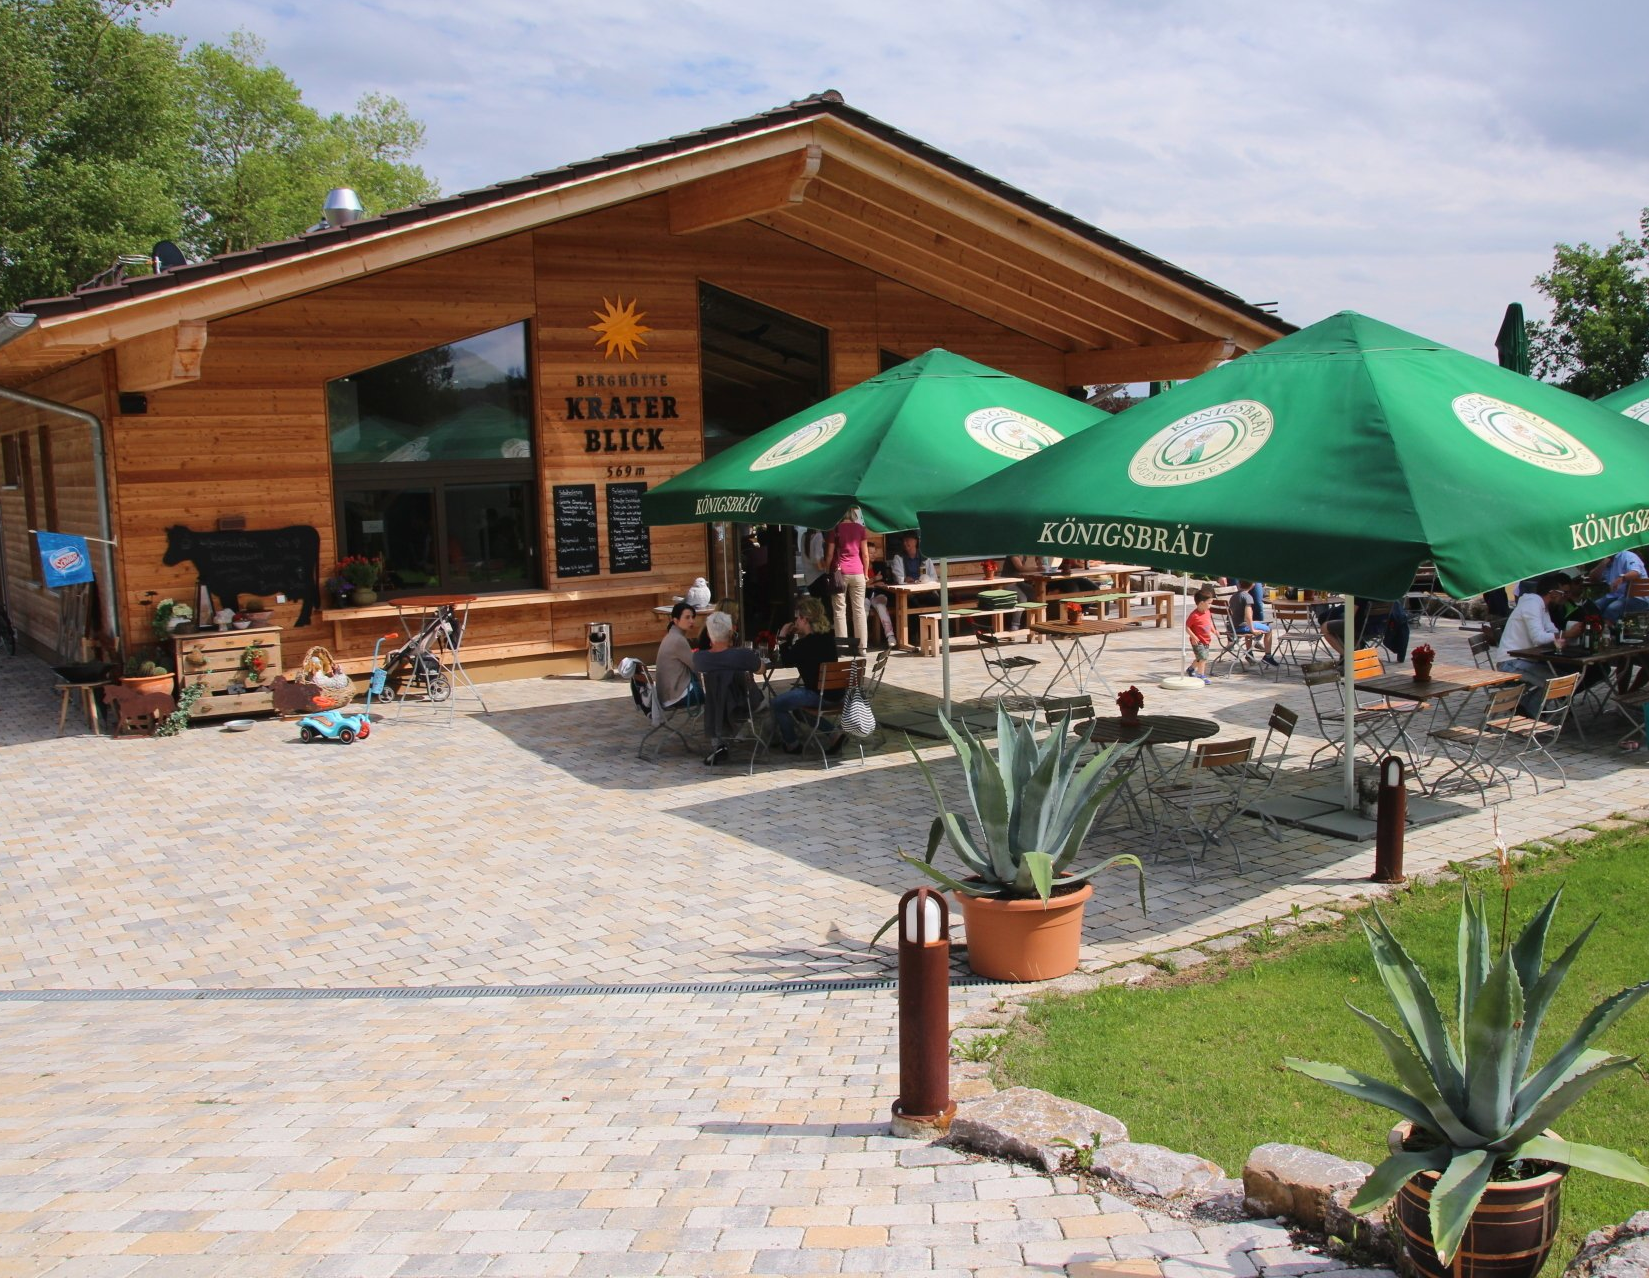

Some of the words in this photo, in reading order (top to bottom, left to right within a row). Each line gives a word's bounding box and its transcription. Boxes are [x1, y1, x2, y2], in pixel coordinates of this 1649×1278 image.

[576, 373, 668, 387] BERGHÜTTE
[564, 396, 680, 420] KRATER
[1170, 403, 1271, 438] KÖNIGSBRÄU
[583, 427, 665, 453] BLICK
[606, 465, 632, 478] 569
[635, 466, 645, 477] m
[694, 492, 764, 516] KÖNIGSBRÄU
[1036, 516, 1214, 558] KÖNIGSBRÄU
